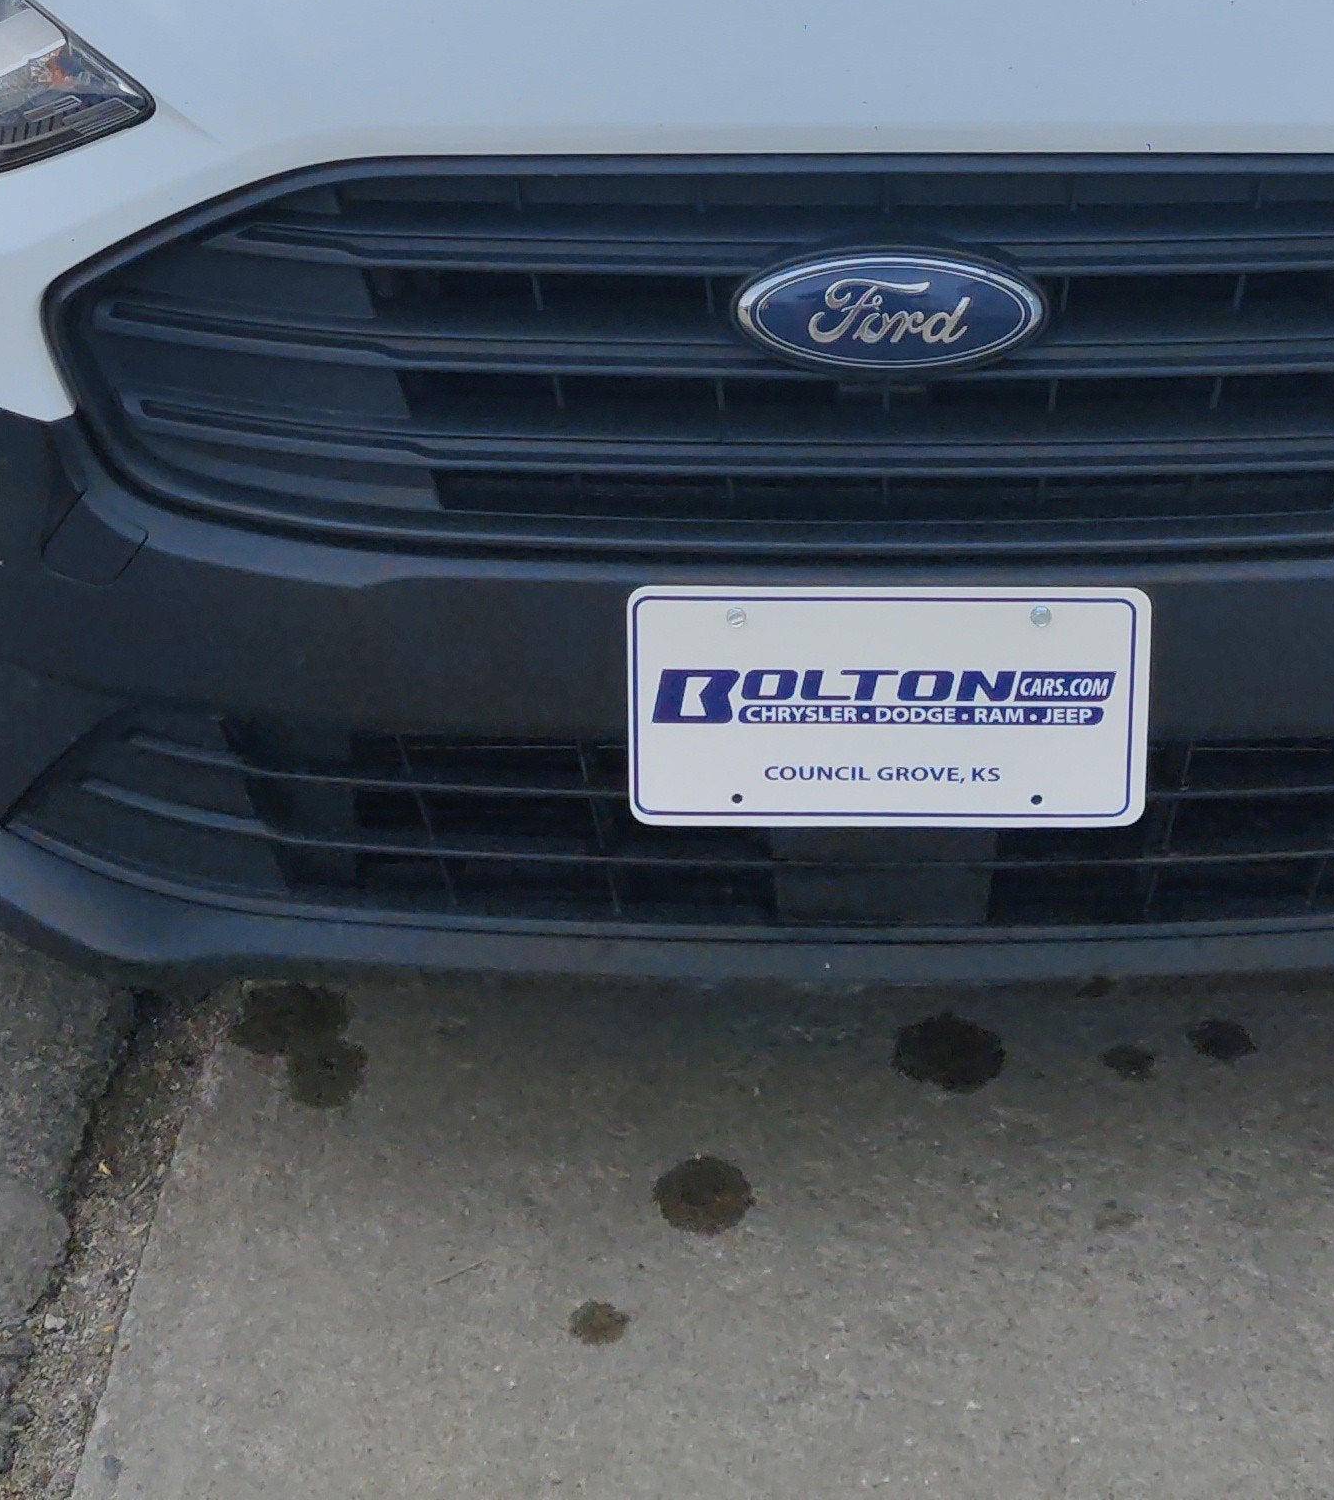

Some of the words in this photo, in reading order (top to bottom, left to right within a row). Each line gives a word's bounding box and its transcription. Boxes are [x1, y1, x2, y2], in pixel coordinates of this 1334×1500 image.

[807, 278, 971, 344] Ford
[651, 668, 1018, 724] BOLTON
[1019, 677, 1110, 697] CARS.COM
[745, 706, 858, 722] CHRYSLER
[874, 706, 957, 723] DODGE
[974, 707, 1025, 724] RAM
[1041, 708, 1093, 724] JEEP
[763, 766, 871, 781] COUNCIL
[876, 766, 965, 785] GROVE,
[971, 767, 1001, 782] KS
